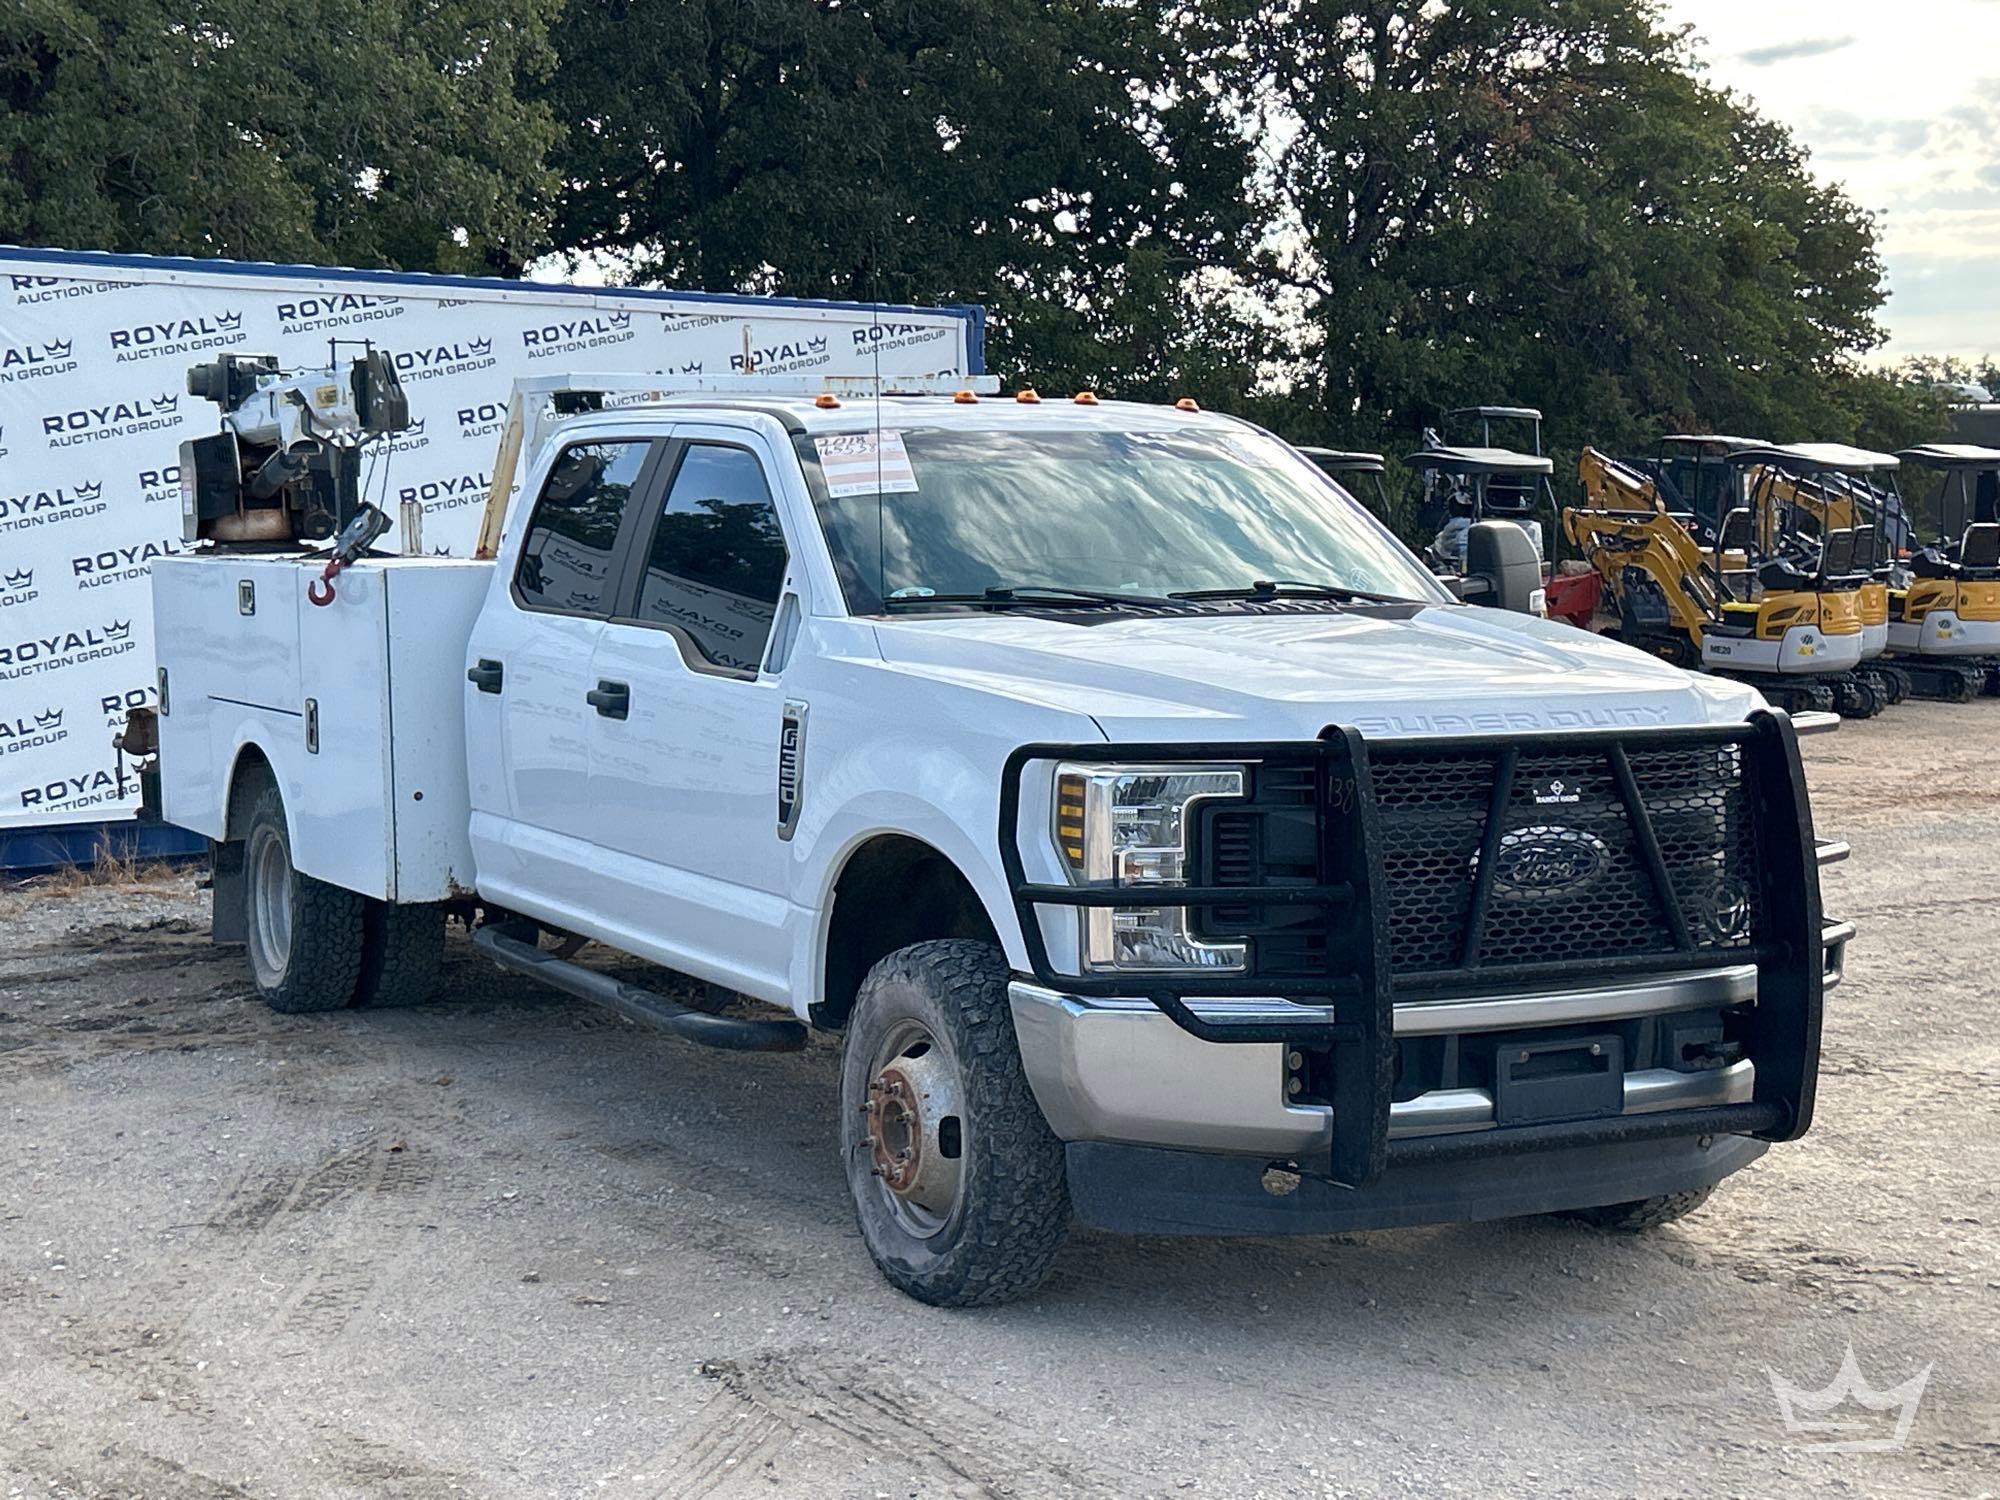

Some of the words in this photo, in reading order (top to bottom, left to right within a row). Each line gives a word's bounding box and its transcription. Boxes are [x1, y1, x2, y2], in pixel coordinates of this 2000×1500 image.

[17, 284, 94, 305] AUCTION
[96, 281, 149, 293] GRO
[278, 294, 376, 322] ROYAL
[282, 317, 351, 335] AUCTION
[352, 307, 405, 324] GROUP
[109, 317, 217, 349] ROYAL
[522, 318, 610, 347] ROYAL
[663, 315, 719, 333] AUCTION
[116, 343, 189, 363] AUCTION
[190, 333, 247, 350] GROUP
[527, 341, 588, 359] AUCTION
[589, 331, 635, 350] GROUP
[855, 339, 906, 356] AUCTION
[907, 329, 946, 345] GROUP
[17, 361, 78, 380] GROUP
[395, 344, 469, 370] OYAL
[399, 368, 444, 383] CTION
[445, 357, 497, 375] GROUP
[753, 363, 788, 376] TION
[789, 354, 831, 371] GROUP
[603, 392, 651, 409] AUCTIO
[42, 401, 153, 435] ROYAL
[463, 423, 505, 438] AUCTI
[49, 427, 124, 449] AUCTION
[126, 415, 184, 434] GROUP
[399, 473, 493, 504] ROYAL
[0, 515, 45, 533] TION
[47, 503, 107, 523] GROUP
[424, 497, 468, 514] CTION
[72, 539, 180, 576] ROYAL
[78, 565, 153, 590] AUCTION
[0, 590, 39, 606] OUP
[0, 655, 75, 681] AUCTION
[76, 641, 136, 663] GROUP
[1351, 712, 1543, 737] SUPER
[1548, 704, 1671, 727] DUTY
[8, 730, 68, 753] GROUP
